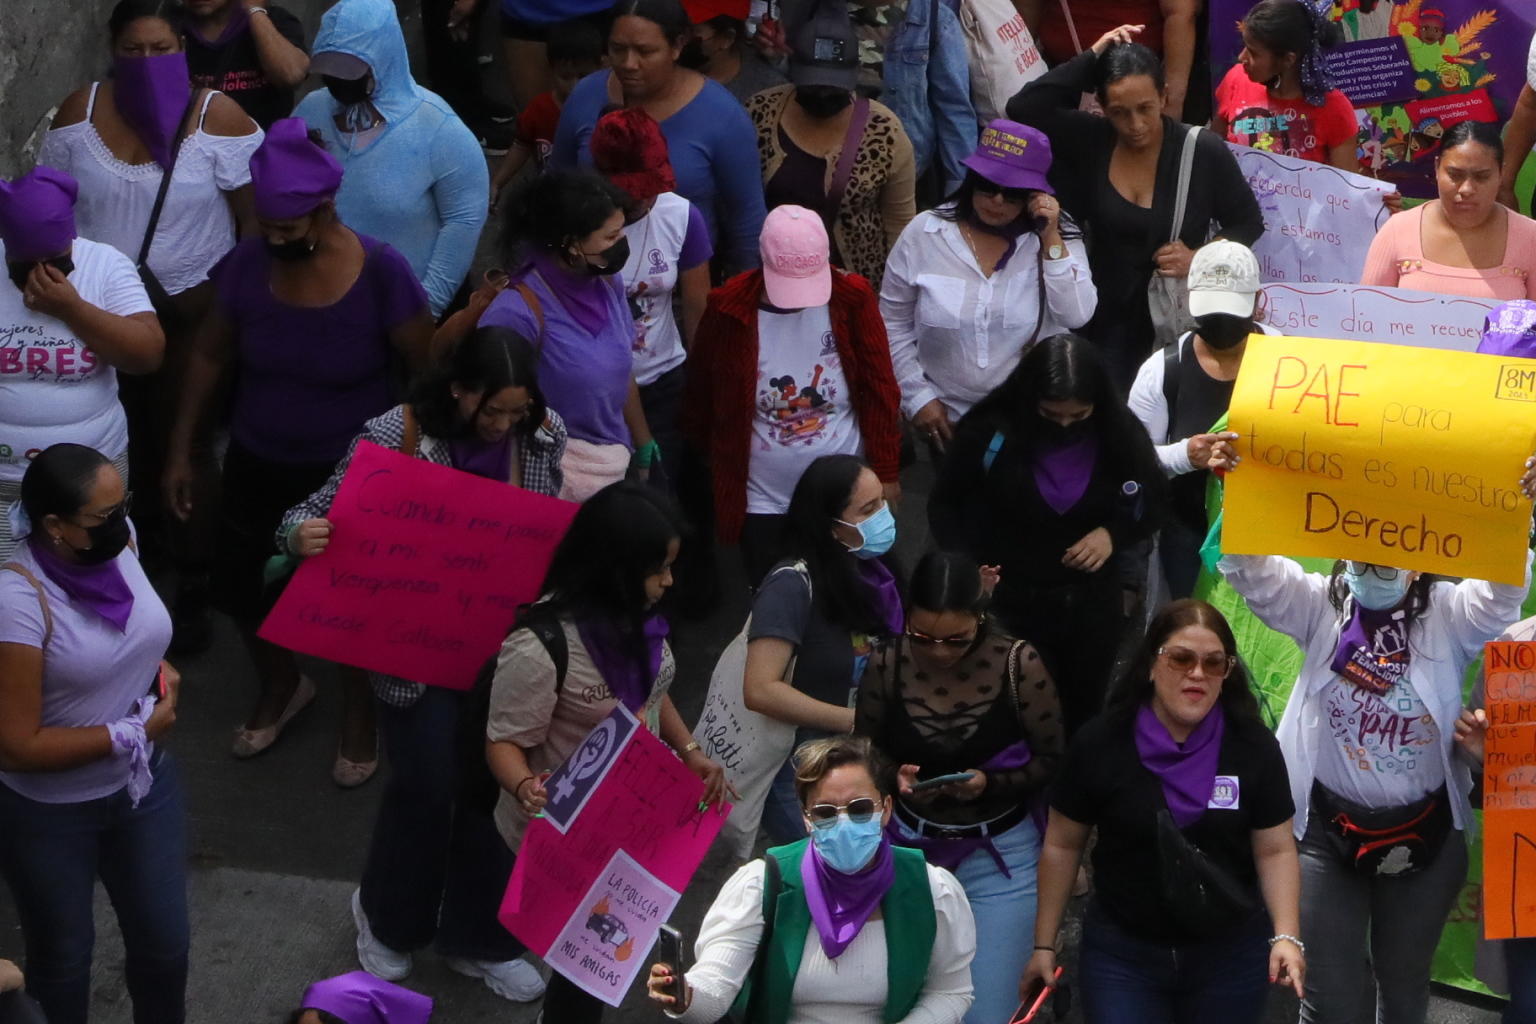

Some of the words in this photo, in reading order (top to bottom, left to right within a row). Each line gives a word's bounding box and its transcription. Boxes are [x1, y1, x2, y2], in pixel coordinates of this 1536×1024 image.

[1344, 47, 1388, 59] germinamos
[1346, 55, 1387, 67] Campesino
[1419, 101, 1465, 114] Alimentamos
[1472, 98, 1482, 106] los
[1327, 194, 1350, 214] que
[1280, 207, 1342, 246] estamos
[1268, 296, 1320, 328] Este
[1390, 323, 1415, 336] me
[33, 338, 76, 349] niñas
[0, 347, 98, 375] BRES
[1504, 368, 1536, 392] 8M
[1267, 355, 1367, 427] PAE
[1378, 401, 1452, 447] para
[1240, 423, 1344, 479] todas
[1364, 458, 1398, 488] es
[1413, 465, 1518, 513] nuestro
[1304, 491, 1463, 558] Derecho
[1491, 644, 1535, 670] NO
[1358, 711, 1420, 753] PAE
[1485, 727, 1518, 749] que
[607, 873, 621, 890] LA
[621, 883, 659, 918] POLICÍA
[561, 939, 578, 960] MIS
[580, 956, 621, 986] AMIGAS
